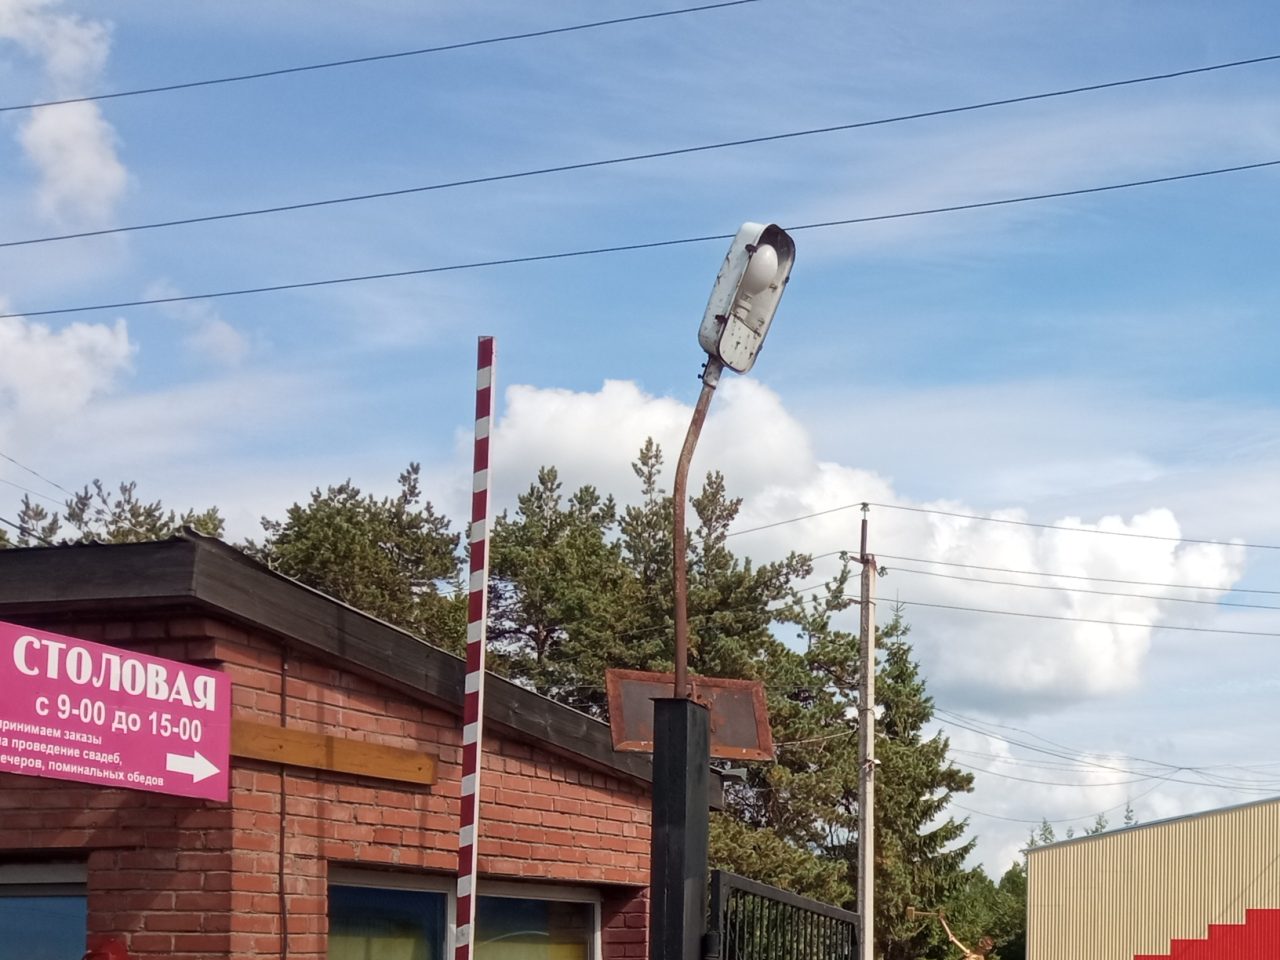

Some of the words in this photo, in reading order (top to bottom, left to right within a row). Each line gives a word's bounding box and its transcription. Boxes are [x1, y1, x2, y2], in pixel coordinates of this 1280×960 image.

[13, 635, 216, 711] СТОЛОВАЯ
[35, 696, 49, 716] с
[57, 694, 106, 725] 9-00
[112, 711, 141, 734] до
[148, 711, 202, 743] 15-00
[0, 736, 8, 747] а
[12, 739, 80, 757] проведение
[83, 750, 122, 766] свадеб,
[64, 729, 102, 745] заказы
[48, 761, 124, 780] поминальных
[127, 771, 164, 786] обедов
